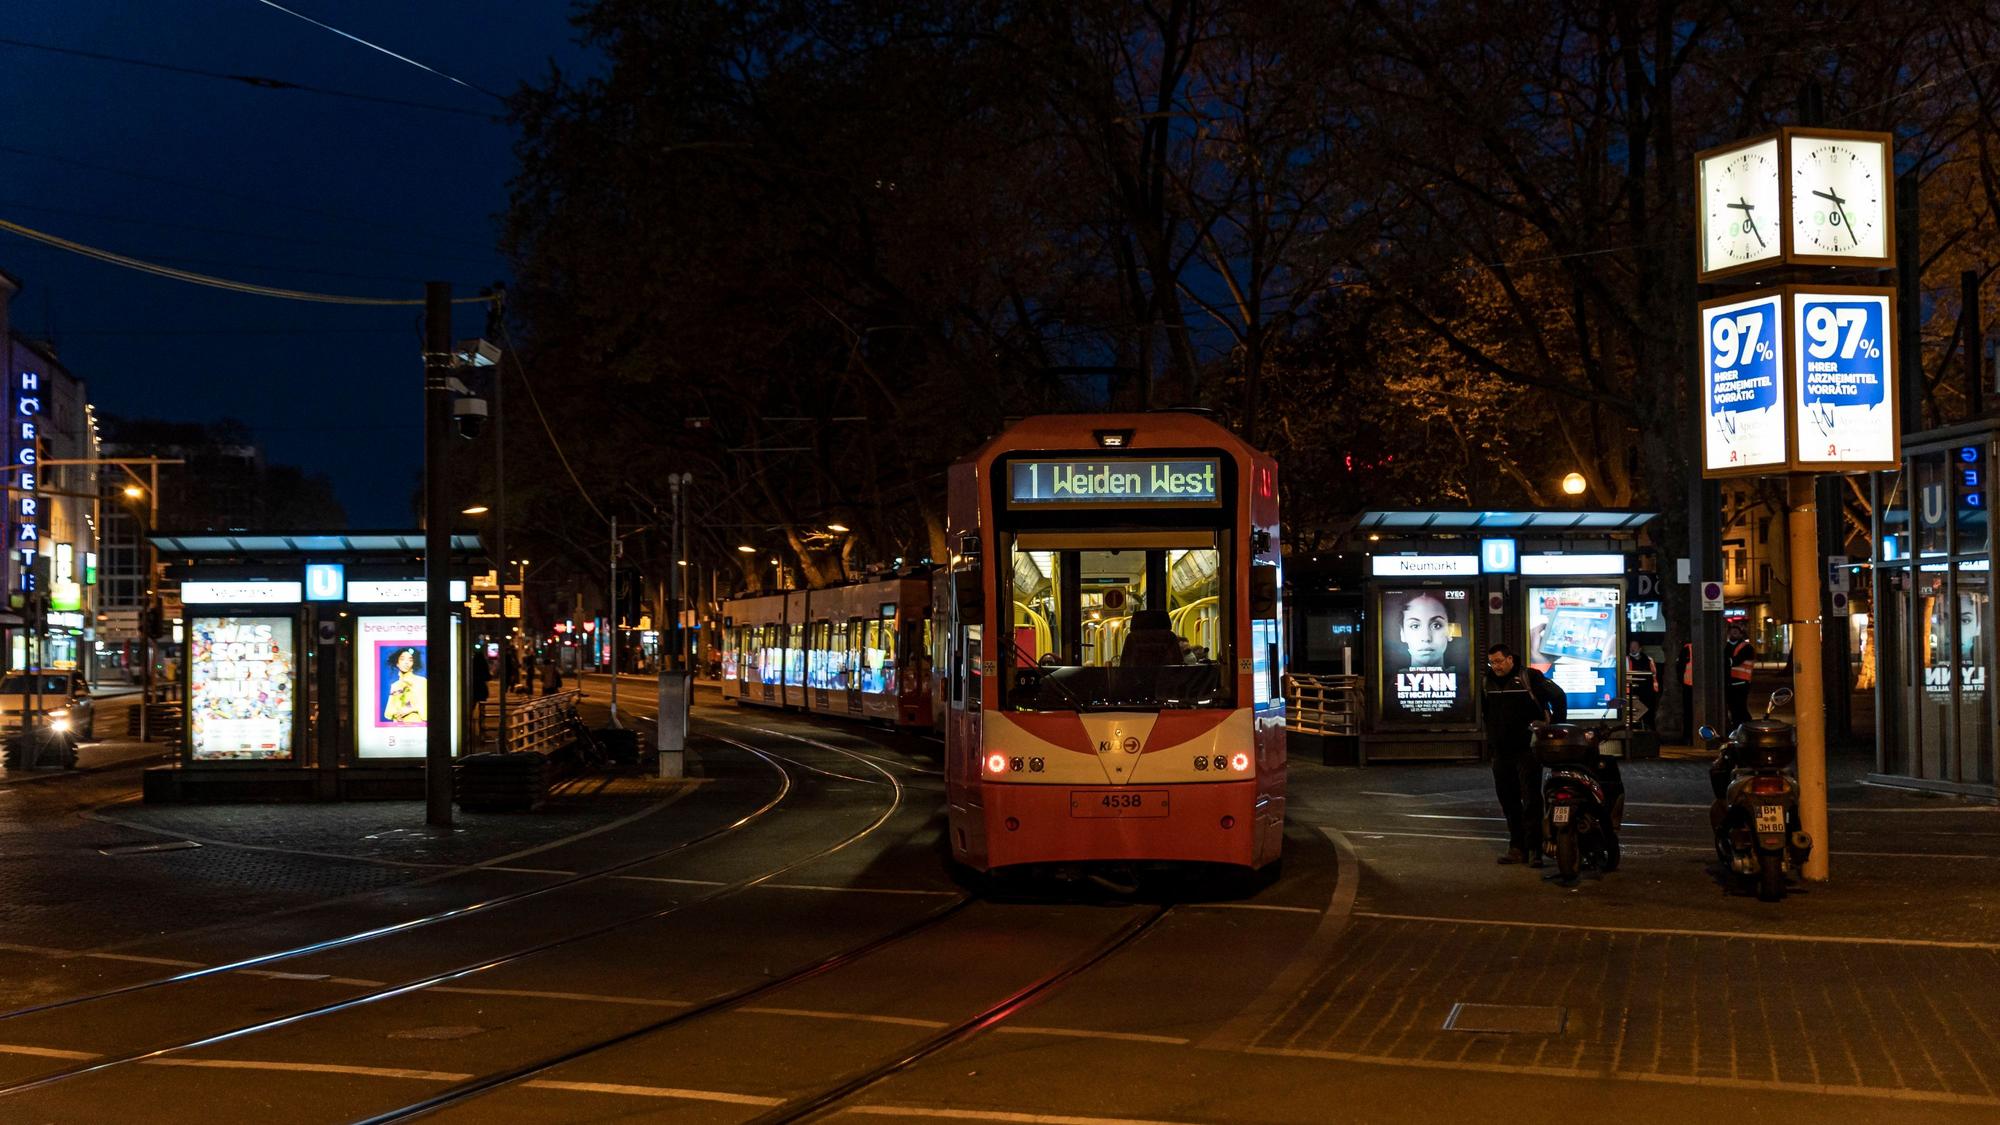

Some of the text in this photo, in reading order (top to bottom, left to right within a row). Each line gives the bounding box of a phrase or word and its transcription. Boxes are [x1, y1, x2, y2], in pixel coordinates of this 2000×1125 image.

[1712, 311, 1774, 369] 97%
[1805, 306, 1880, 359] 97%
[1807, 361, 1838, 372] IHRER
[1713, 369, 1739, 382] IHRER
[1807, 373, 1878, 384] ARZNEIMITTEL
[1713, 375, 1773, 393] ARZNEIMITTEL
[1807, 382, 1858, 395] VORRÄTIG
[1713, 388, 1755, 404] VORRÄTIG
[1029, 463, 1214, 499] 1 Weiden West
[1488, 543, 1509, 568] U
[1400, 560, 1457, 572] Neumarkt
[312, 568, 337, 597] U
[1397, 673, 1456, 691] LYNN
[1397, 691, 1410, 699] IST
[1102, 794, 1142, 808] 4538
[1763, 806, 1777, 815] BM
